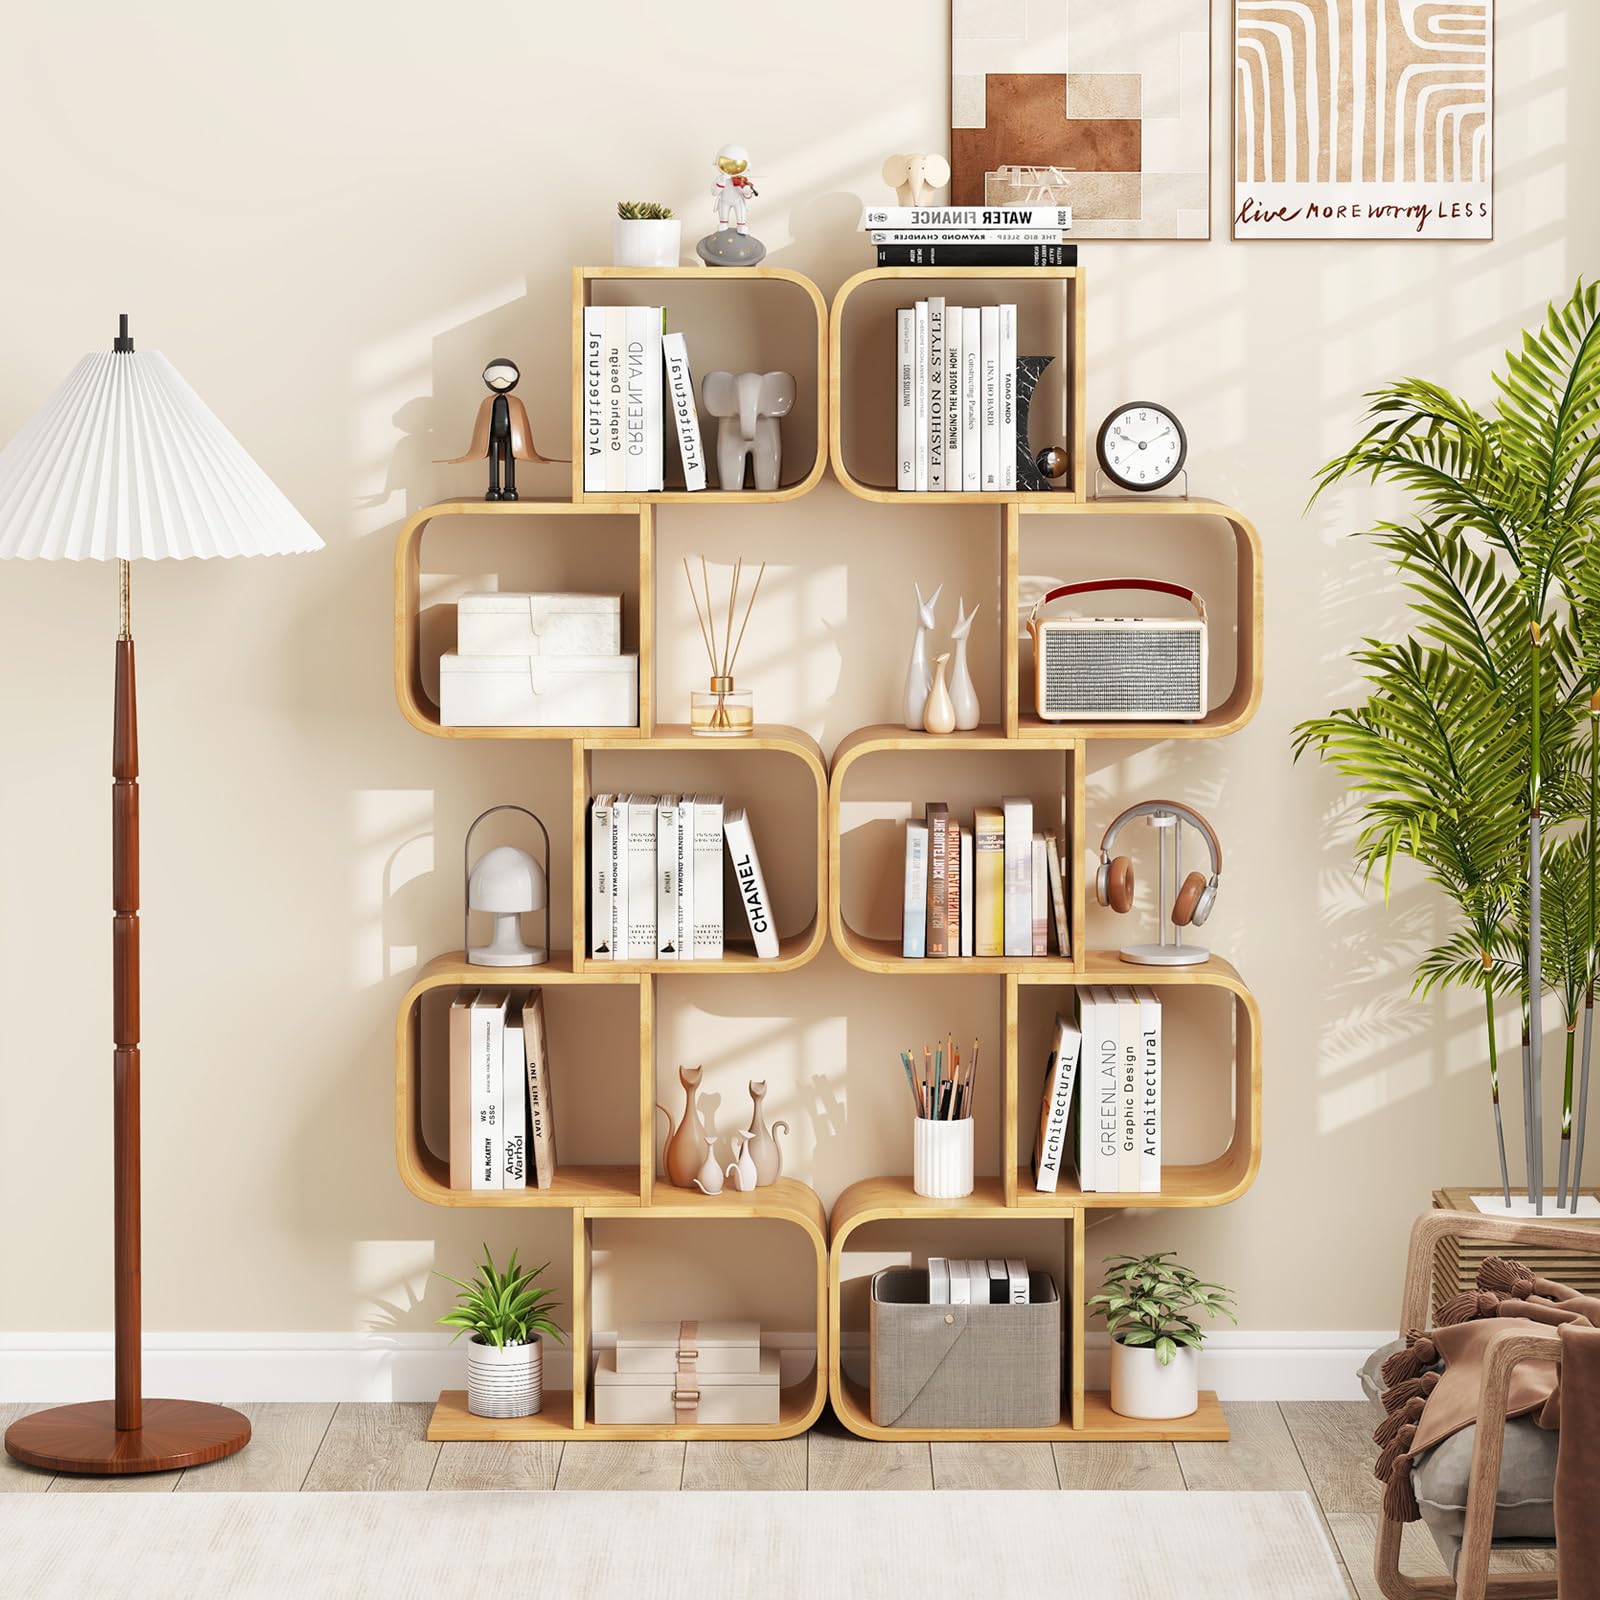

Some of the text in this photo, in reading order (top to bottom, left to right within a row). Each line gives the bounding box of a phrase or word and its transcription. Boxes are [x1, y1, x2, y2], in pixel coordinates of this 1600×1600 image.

[1234, 196, 1487, 232] live MORE worry LESS
[967, 353, 976, 399] Constructing
[931, 312, 941, 466] FASHION & STYLE
[949, 348, 958, 449] BRINGING THE HOUSE HOME
[987, 360, 995, 426] LINA BO BARDI
[1125, 416, 1131, 424] 11
[1139, 412, 1147, 421] 12
[1113, 427, 1121, 435] 10
[1110, 442, 1115, 450] 9
[1114, 456, 1120, 464] 8
[1126, 466, 1131, 474] 7
[1155, 466, 1159, 475] 5
[1165, 456, 1170, 464] 4
[1140, 471, 1145, 479] 6
[736, 854, 768, 933] CHANEL
[529, 1062, 537, 1081] ONE
[531, 1085, 539, 1107] LINE
[1101, 1039, 1117, 1156] GREENLAND
[1123, 1046, 1136, 1151] Graphic Design
[1143, 1029, 1157, 1156] Architectural
[480, 1110, 487, 1122] WS
[1044, 1055, 1074, 1171] Architectural
[534, 1119, 542, 1138] DAY
[505, 1140, 516, 1175] Andy
[514, 1135, 523, 1180] Warhol
